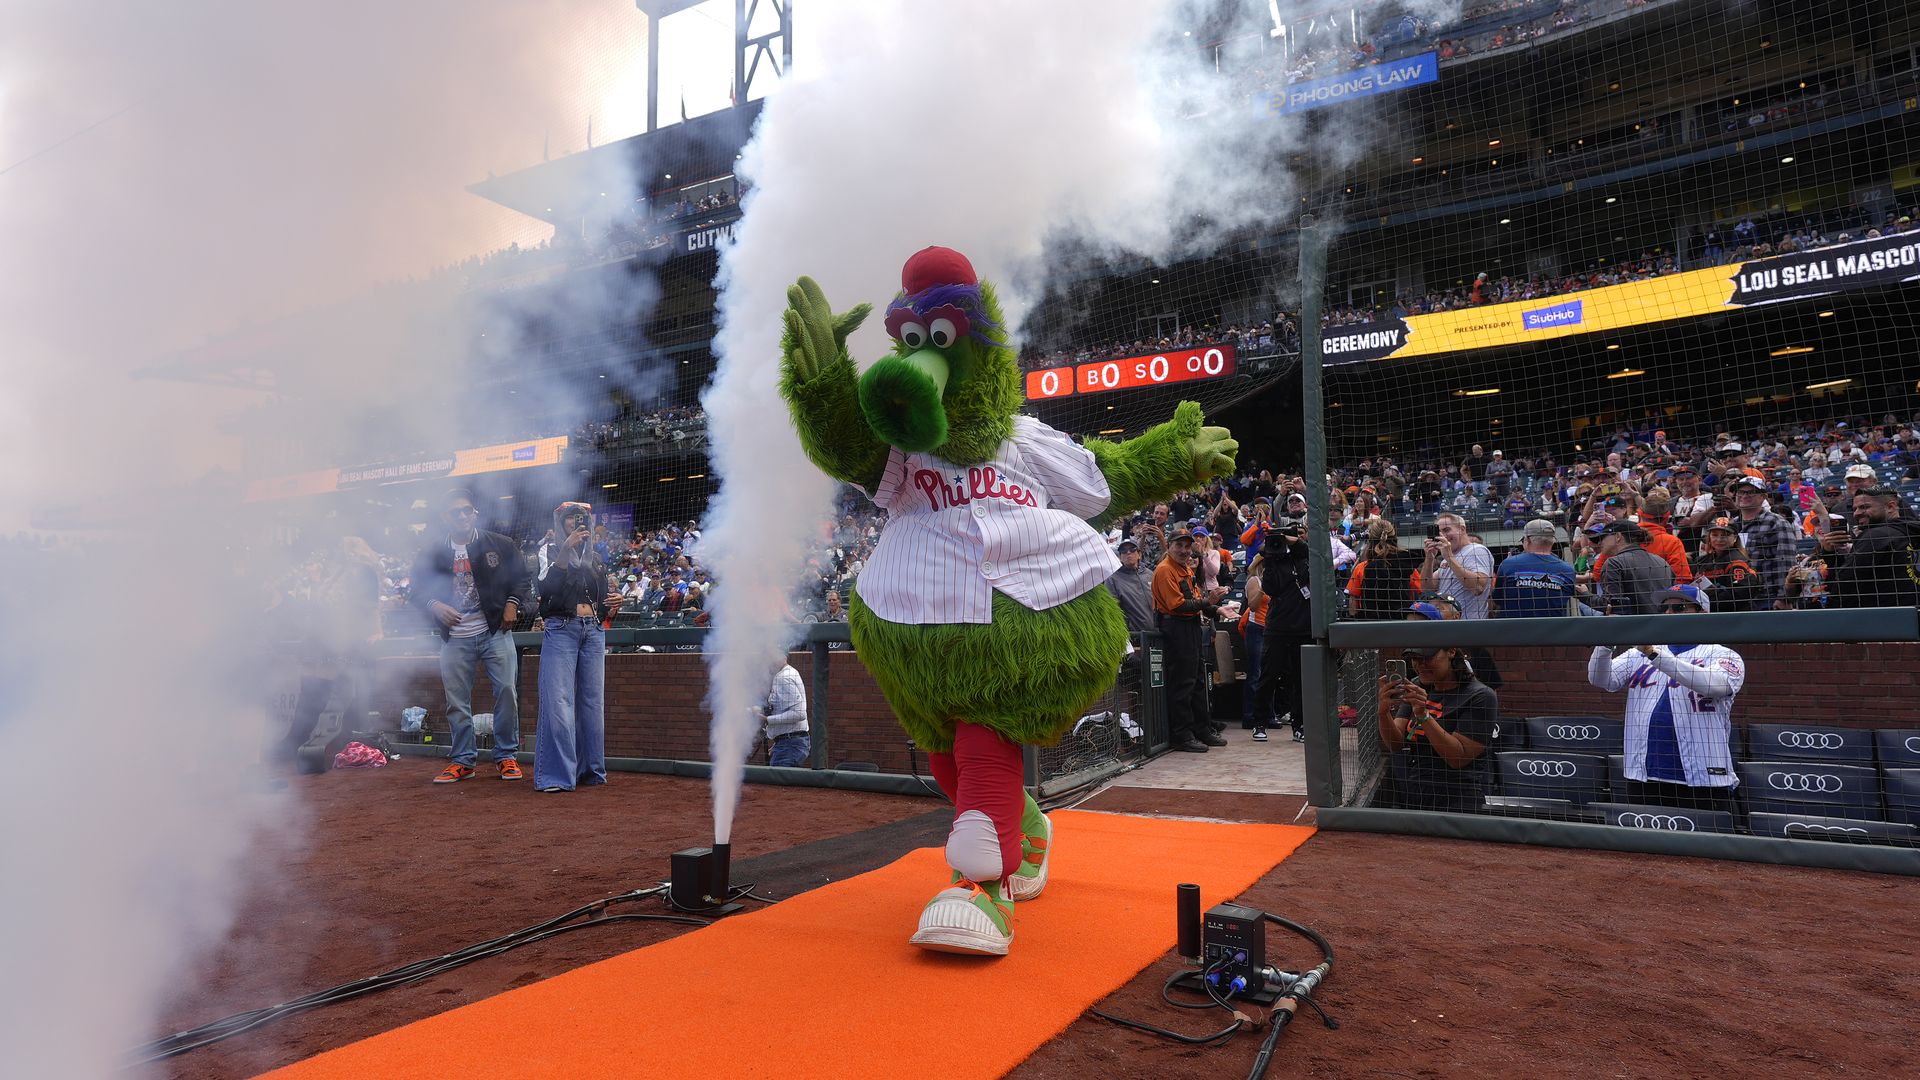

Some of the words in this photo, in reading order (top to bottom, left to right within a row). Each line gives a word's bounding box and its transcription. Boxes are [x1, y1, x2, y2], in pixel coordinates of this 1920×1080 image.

[1290, 76, 1373, 107] PHOONG
[1376, 64, 1423, 87] LAW
[1740, 269, 1779, 293] LOU
[1781, 260, 1834, 286] SEAL
[1322, 329, 1399, 354] CEREMONY
[1454, 323, 1499, 333] PRESENTED
[1041, 371, 1059, 396] 0
[913, 466, 1038, 512] Phillies
[1516, 579, 1561, 590] patagonia
[1688, 690, 1716, 713] 12
